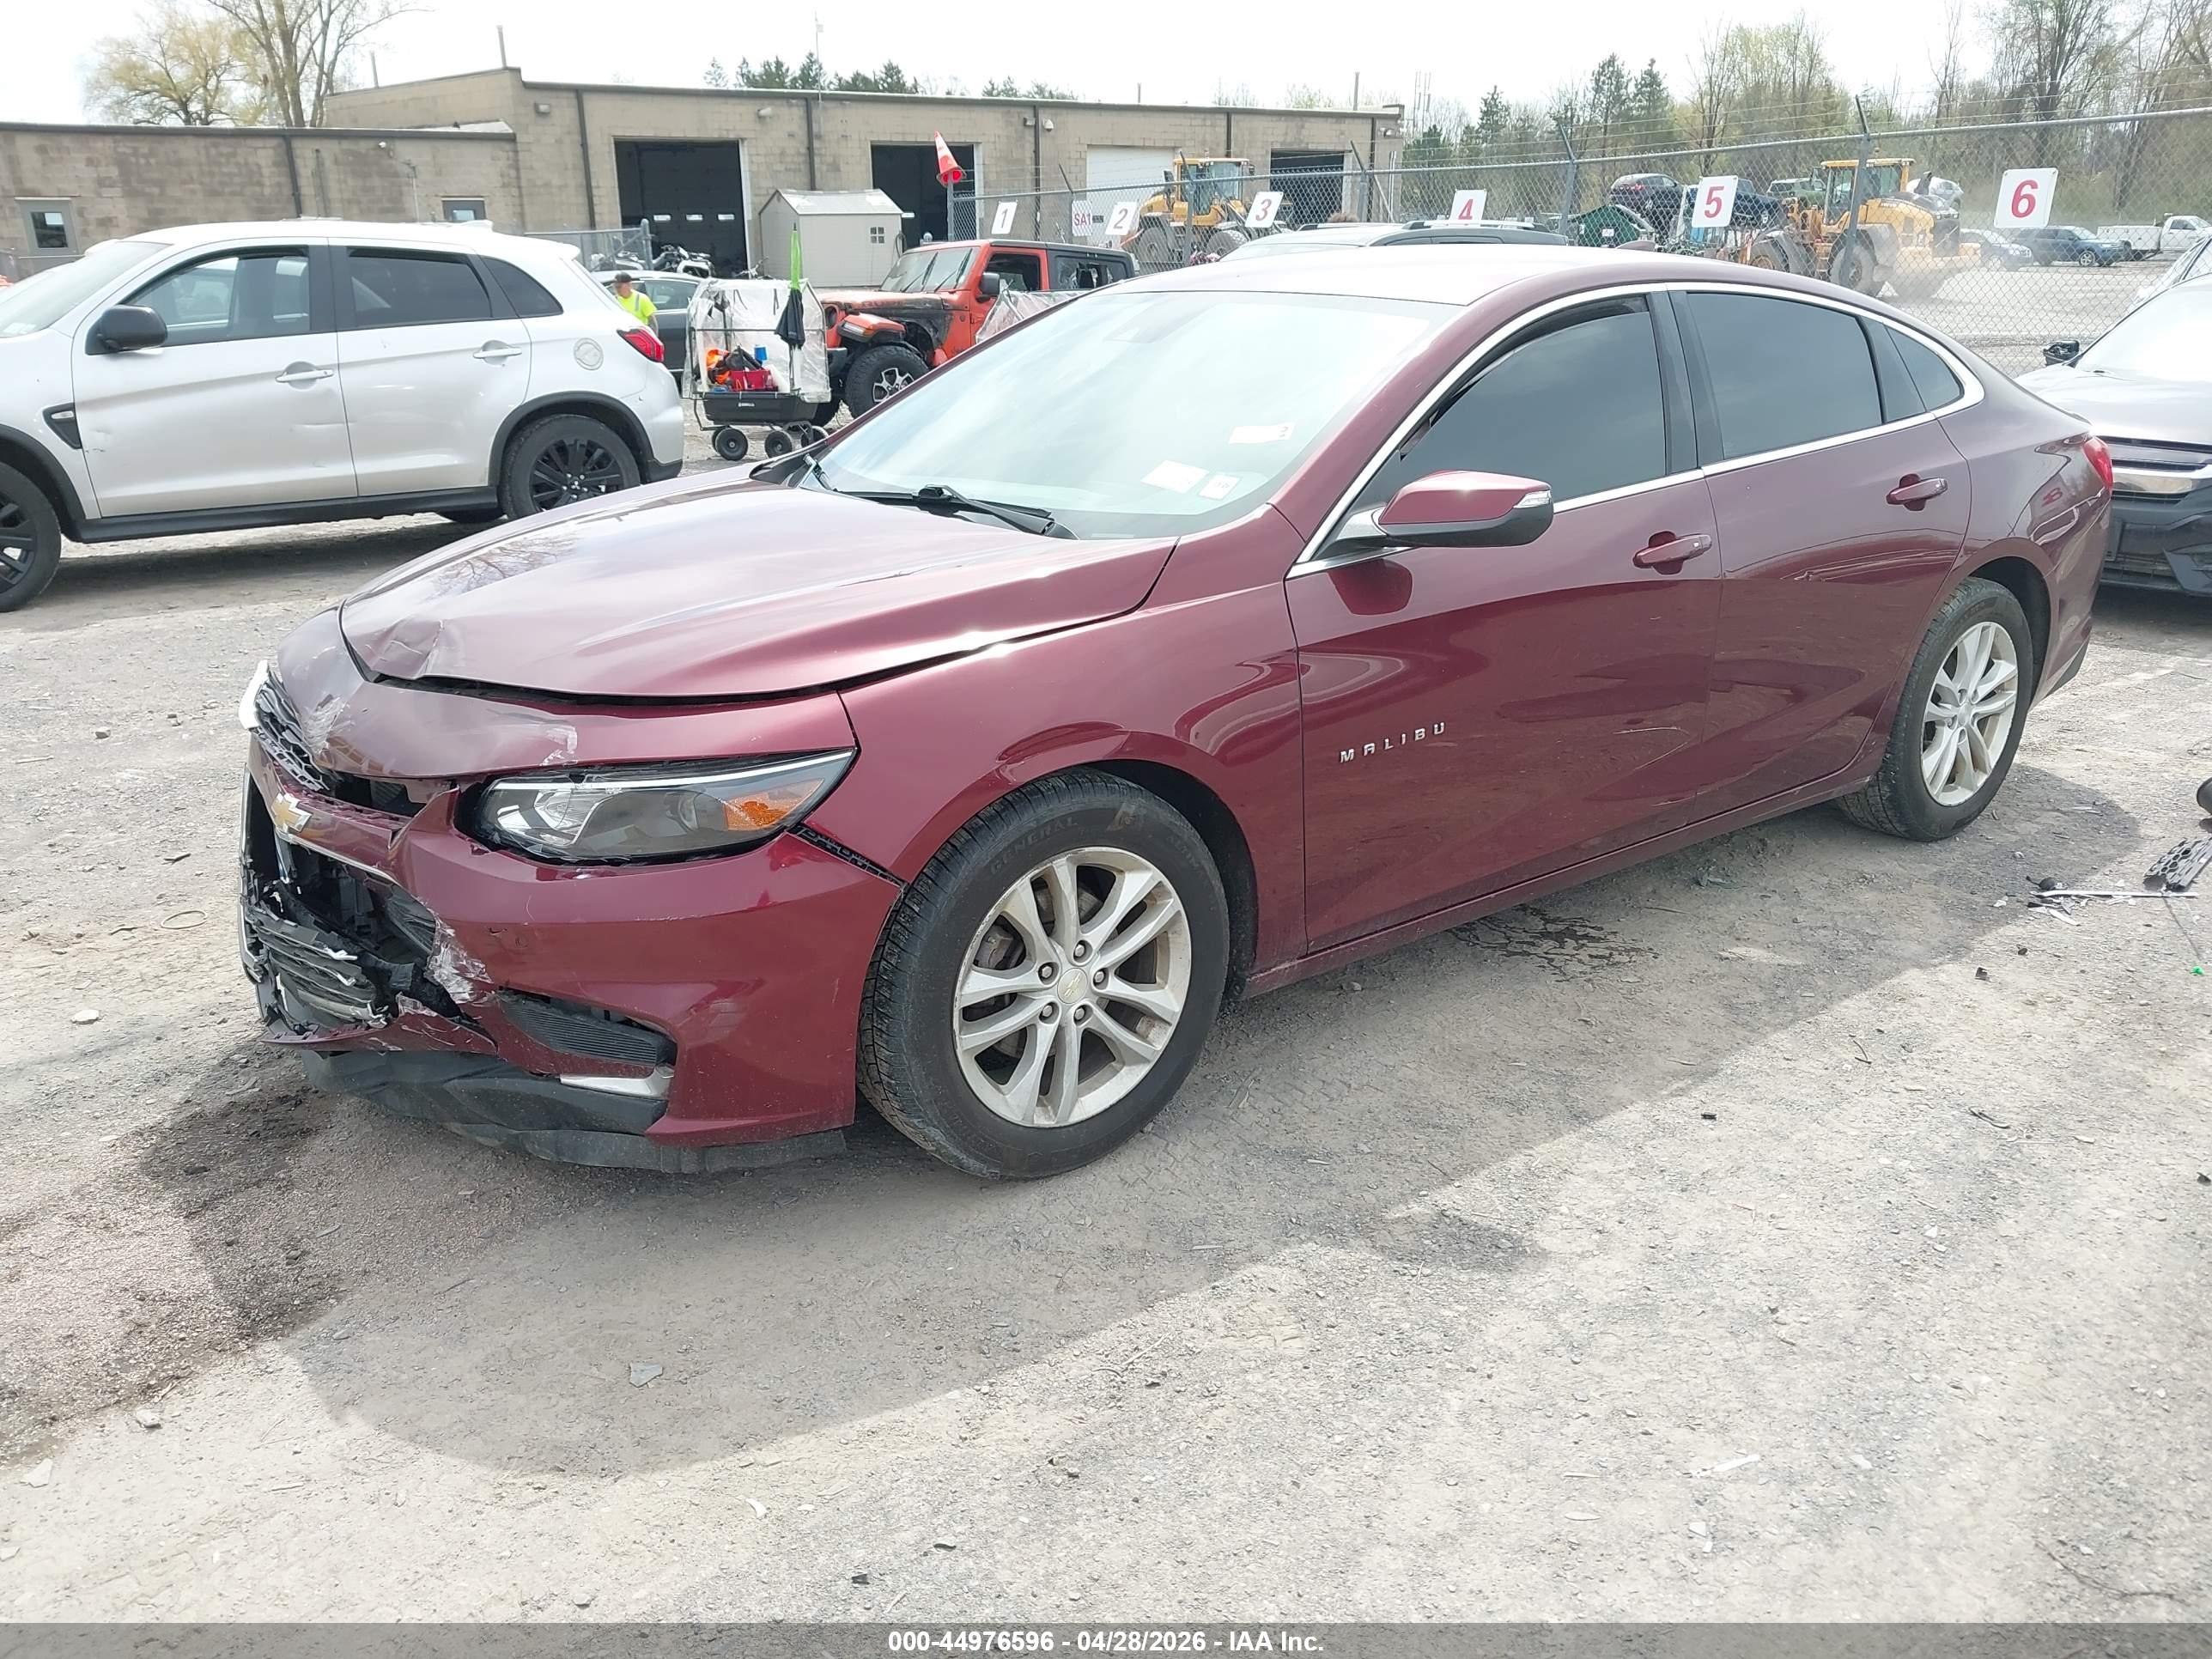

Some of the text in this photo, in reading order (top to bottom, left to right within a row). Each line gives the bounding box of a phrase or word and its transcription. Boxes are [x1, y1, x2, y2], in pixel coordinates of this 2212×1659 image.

[1255, 198, 1273, 222] 3
[1457, 198, 1474, 221] 4
[1704, 185, 1725, 219] 5
[2010, 179, 2039, 219] 6
[1000, 208, 1009, 229] 1
[1113, 208, 1128, 230] 2
[1340, 721, 1445, 763] MALIBU
[990, 815, 1079, 875] GENERAL
